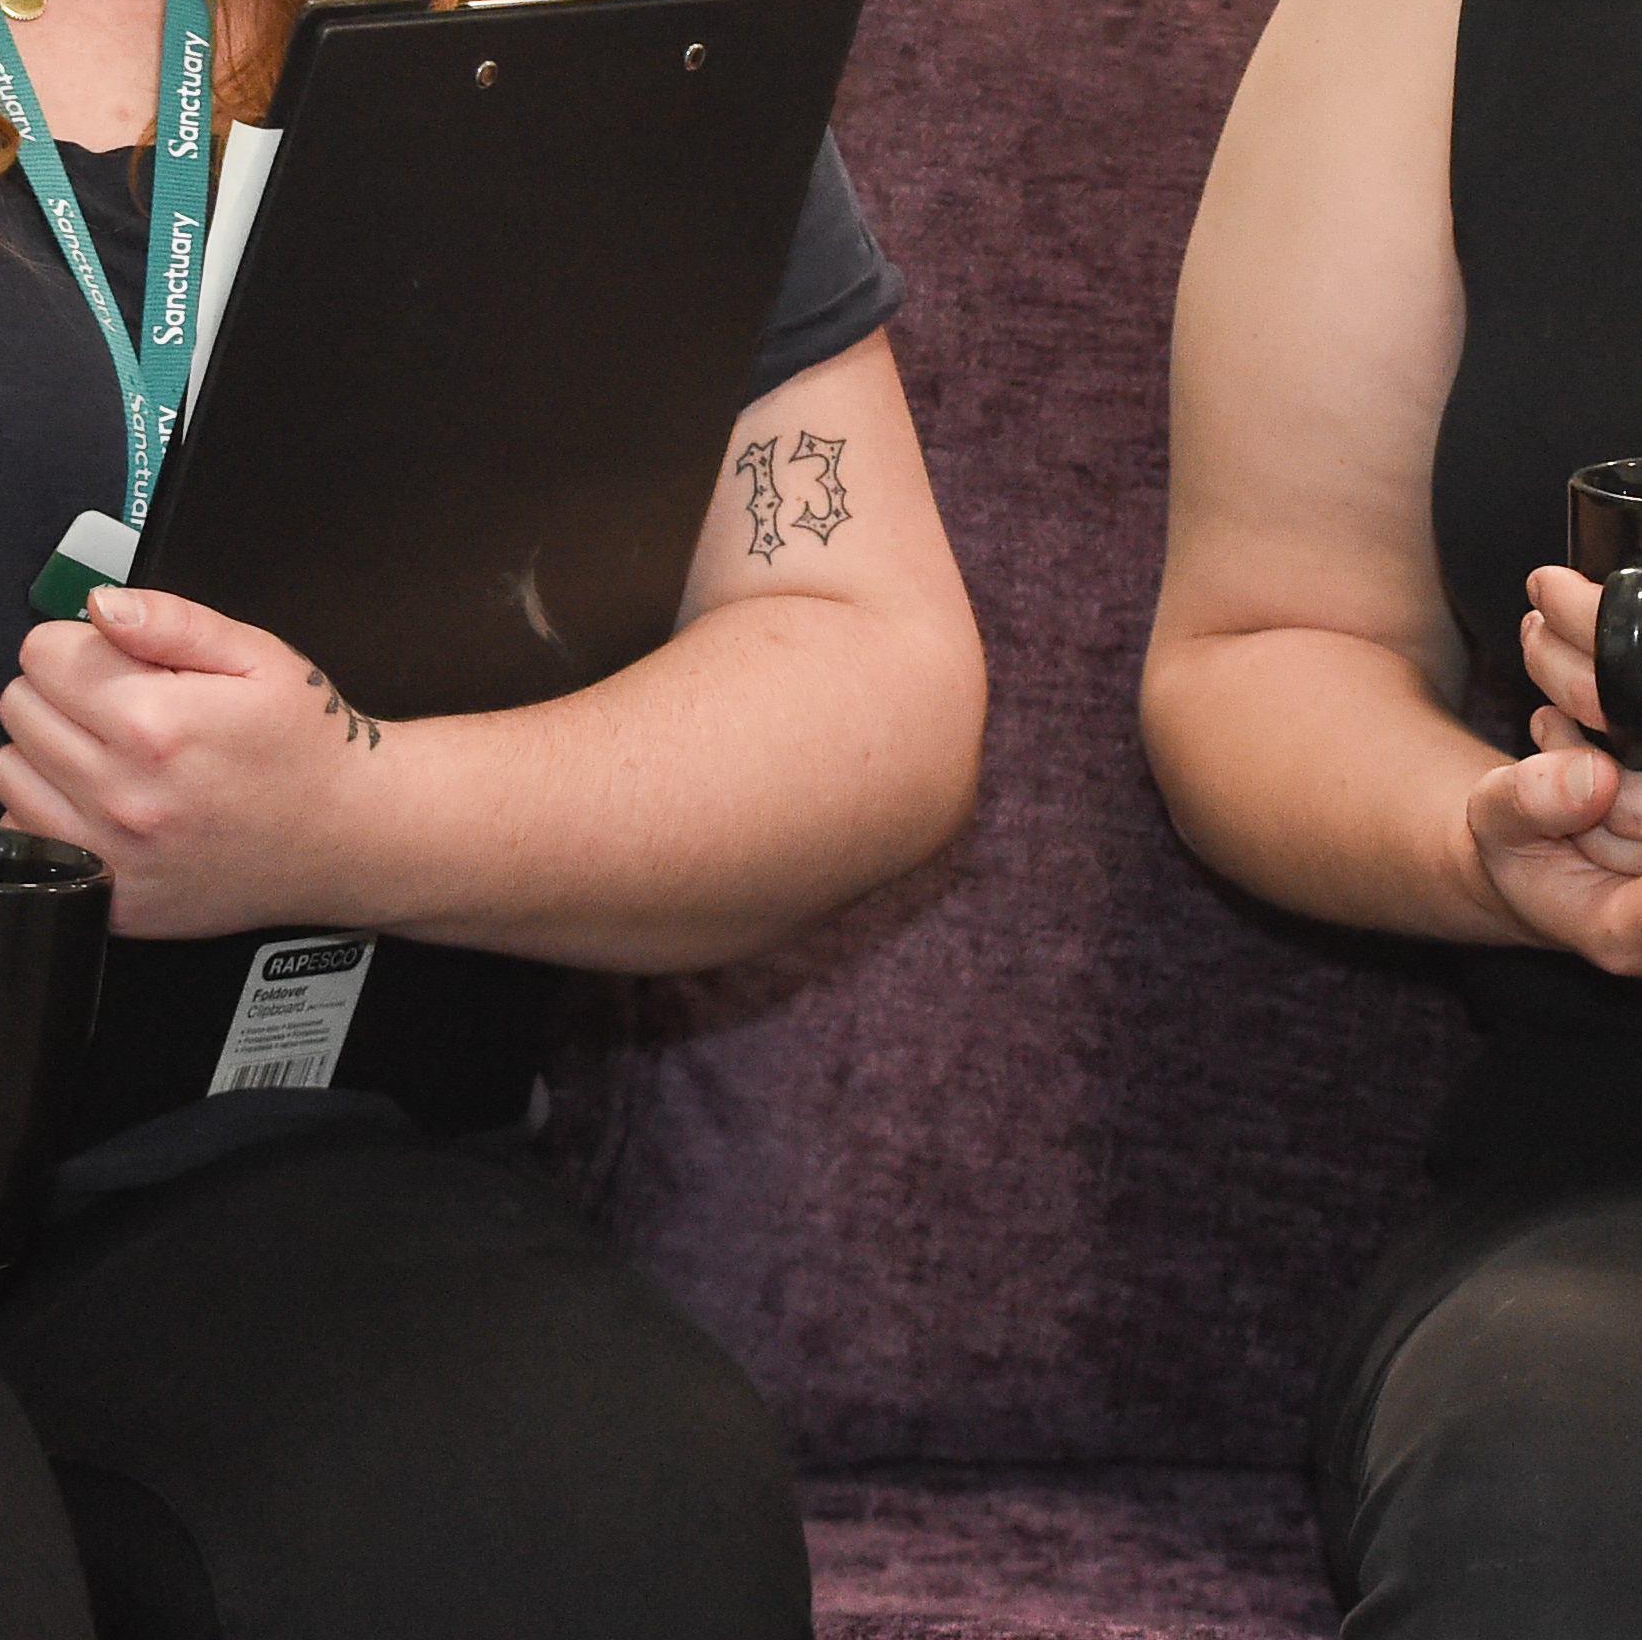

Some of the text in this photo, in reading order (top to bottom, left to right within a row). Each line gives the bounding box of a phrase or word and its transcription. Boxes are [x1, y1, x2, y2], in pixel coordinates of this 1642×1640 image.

[169, 31, 210, 159] Sanctuary
[48, 198, 117, 332] Sanctuary
[153, 212, 199, 346] Sanctuary
[129, 392, 153, 530] Sanctuar
[736, 430, 853, 566] 13
[247, 1000, 307, 1019] Clipboard
[252, 984, 309, 1003] Foldover
[268, 947, 358, 976] RAPESCO
